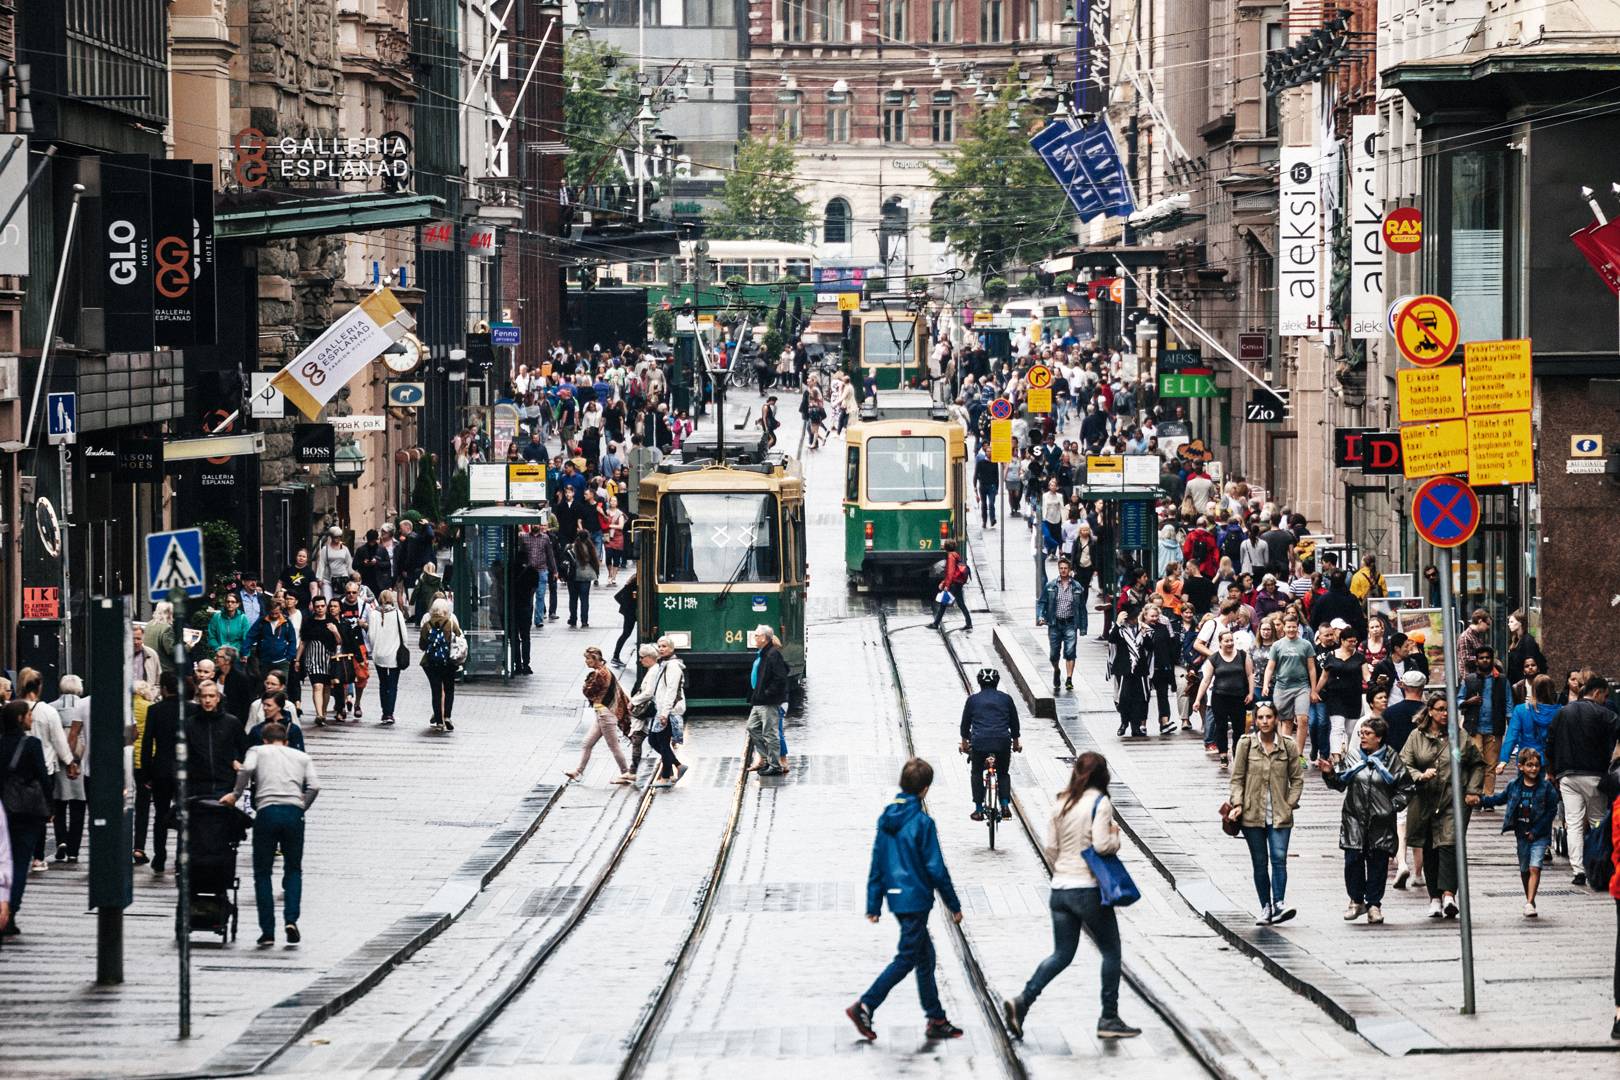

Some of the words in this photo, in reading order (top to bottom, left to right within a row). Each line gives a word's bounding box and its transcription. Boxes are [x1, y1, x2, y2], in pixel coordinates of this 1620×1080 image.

[280, 137, 407, 155] GALLERIA
[281, 160, 408, 177] ESPLANAD
[614, 143, 692, 180] Aktia
[1085, 143, 1122, 194] EVLI
[1294, 167, 1307, 179] 13
[1386, 220, 1422, 235] RAX
[108, 220, 137, 285] GLO
[1282, 191, 1316, 299] aleksi
[317, 320, 365, 361] GALLERIA
[322, 325, 370, 367] ESPLANAD
[1417, 373, 1440, 381] koske
[1247, 404, 1275, 420] Zio
[1472, 431, 1499, 440] stanna
[302, 447, 330, 455] BOSS
[1407, 442, 1422, 450] taxi
[919, 540, 932, 549] 97
[725, 630, 743, 644] 84
